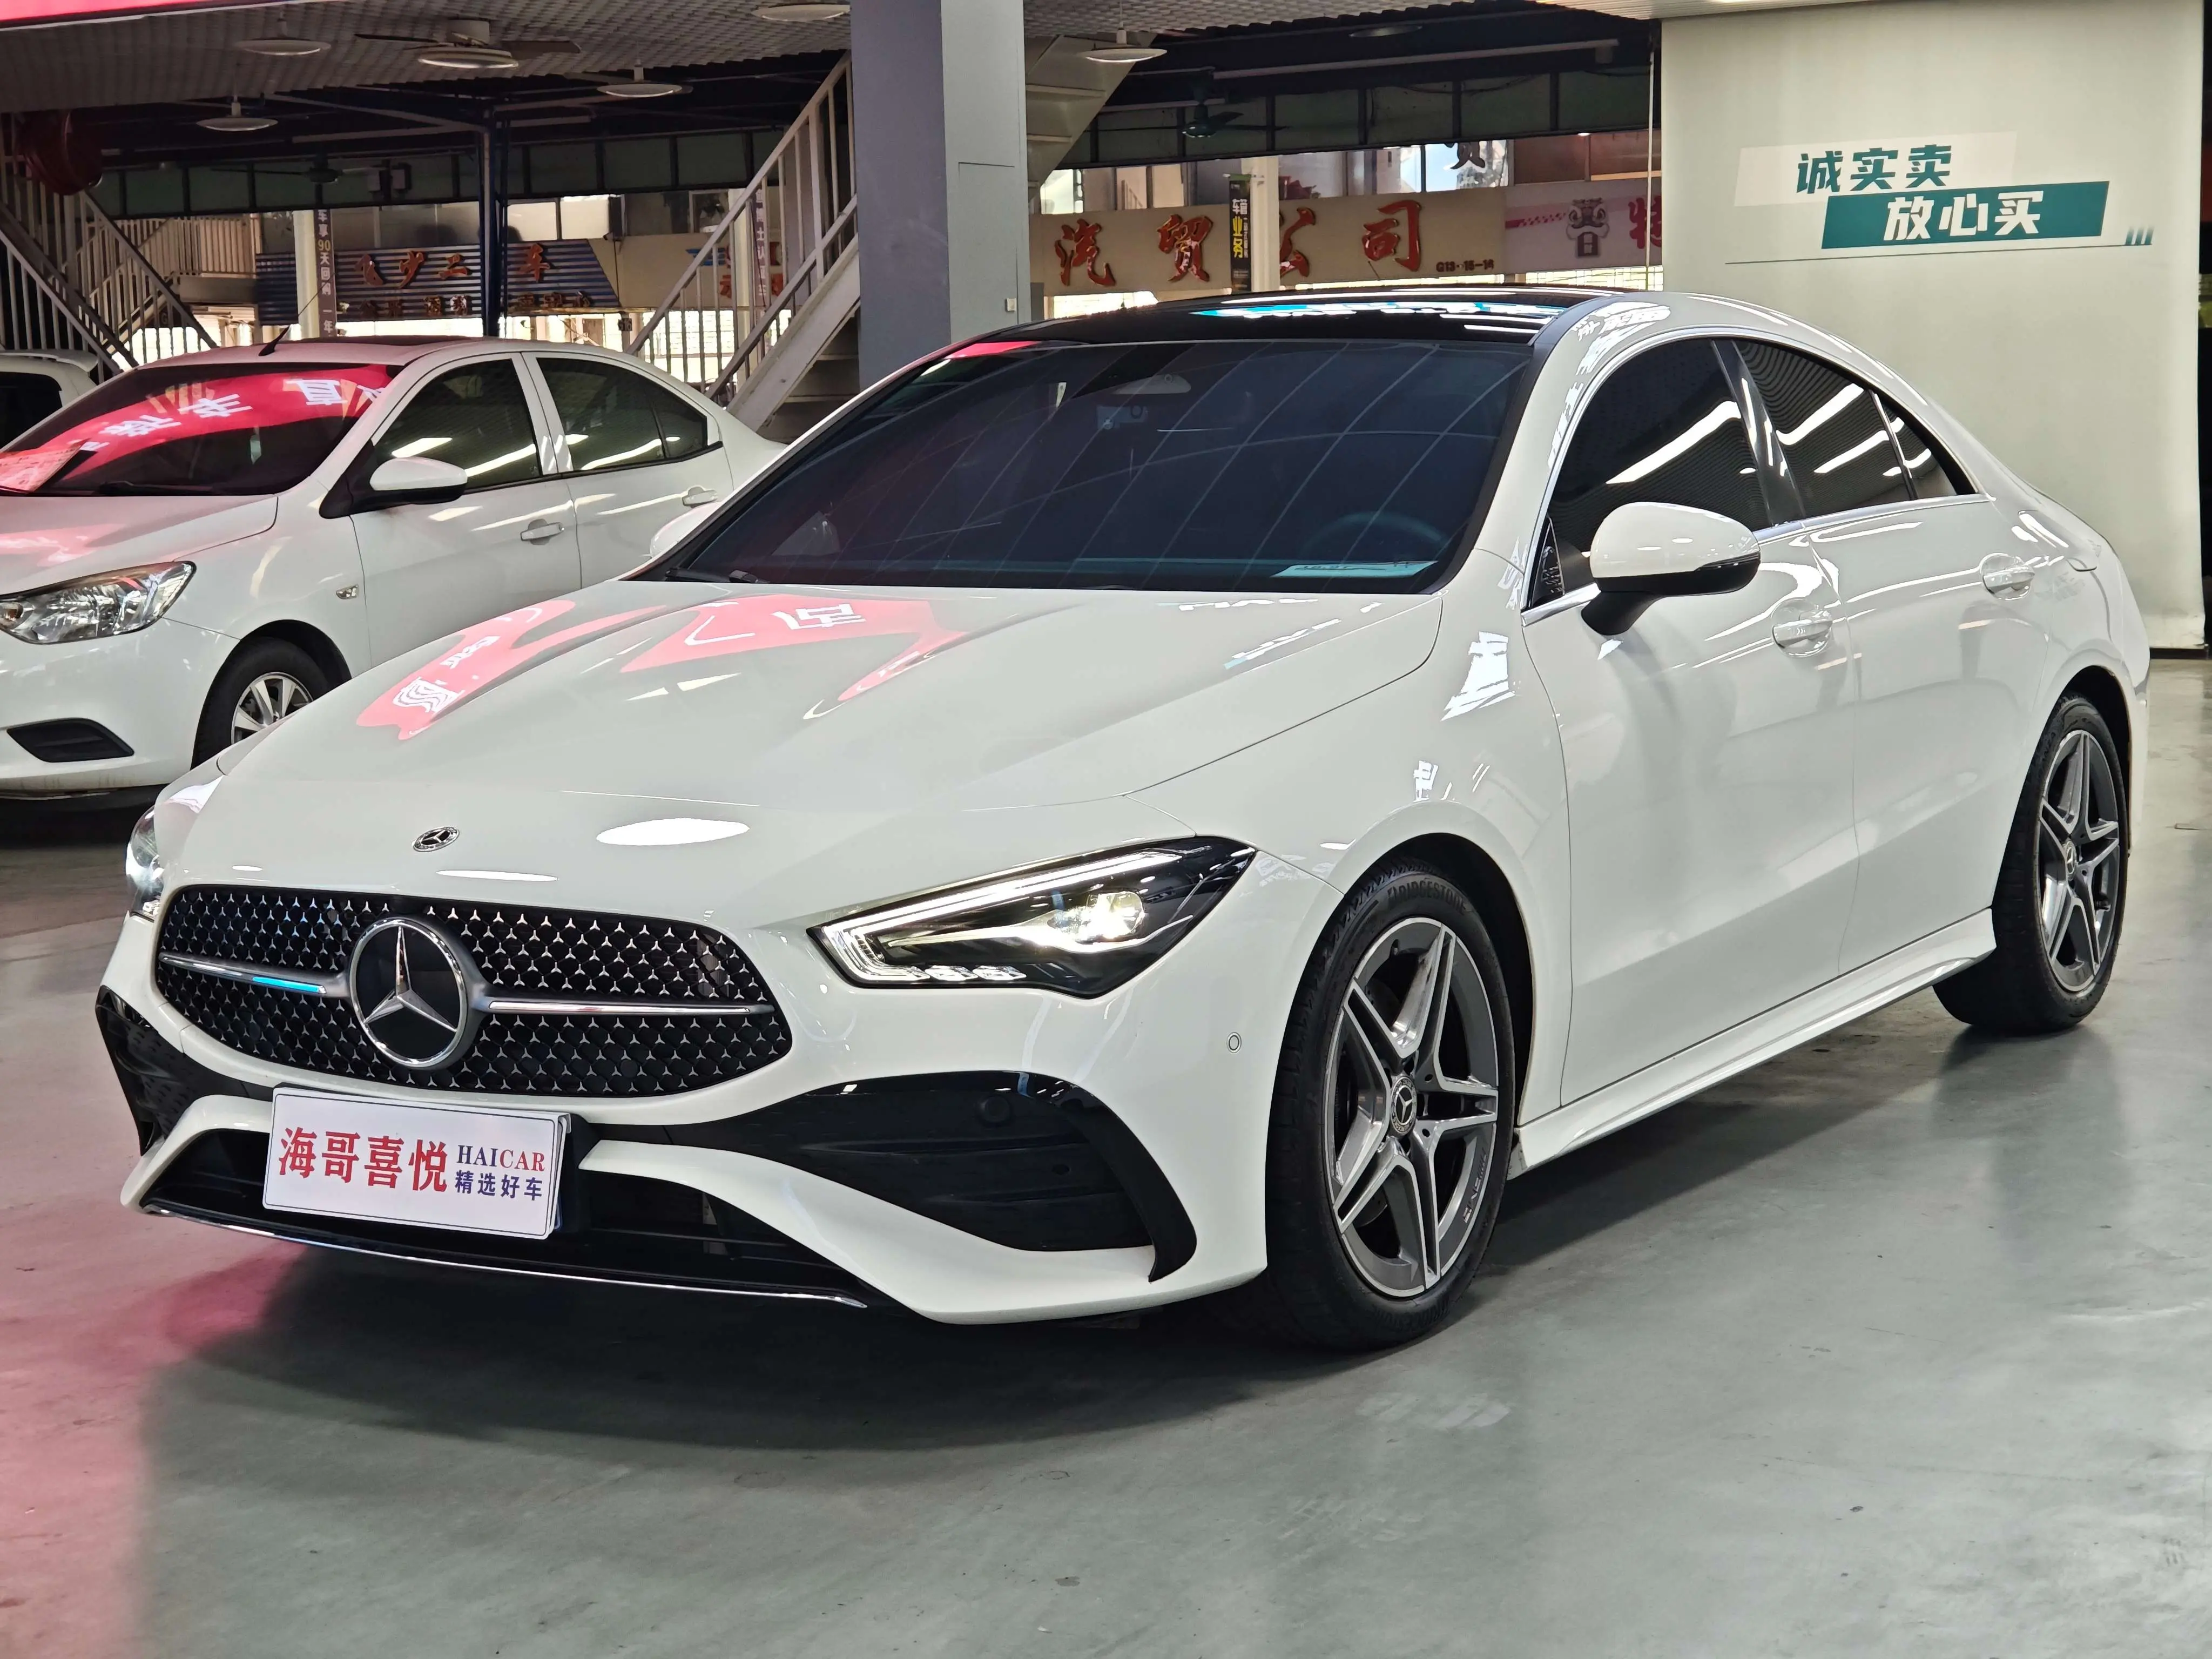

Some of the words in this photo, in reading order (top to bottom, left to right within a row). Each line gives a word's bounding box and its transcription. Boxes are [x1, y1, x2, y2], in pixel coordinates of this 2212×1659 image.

[1796, 144, 1952, 194] 诚实卖
[1883, 191, 2044, 241] 放心买
[278, 1127, 448, 1192] 海哥喜悦
[456, 1144, 545, 1172] HAICAR
[455, 1169, 543, 1202] 精选好车
